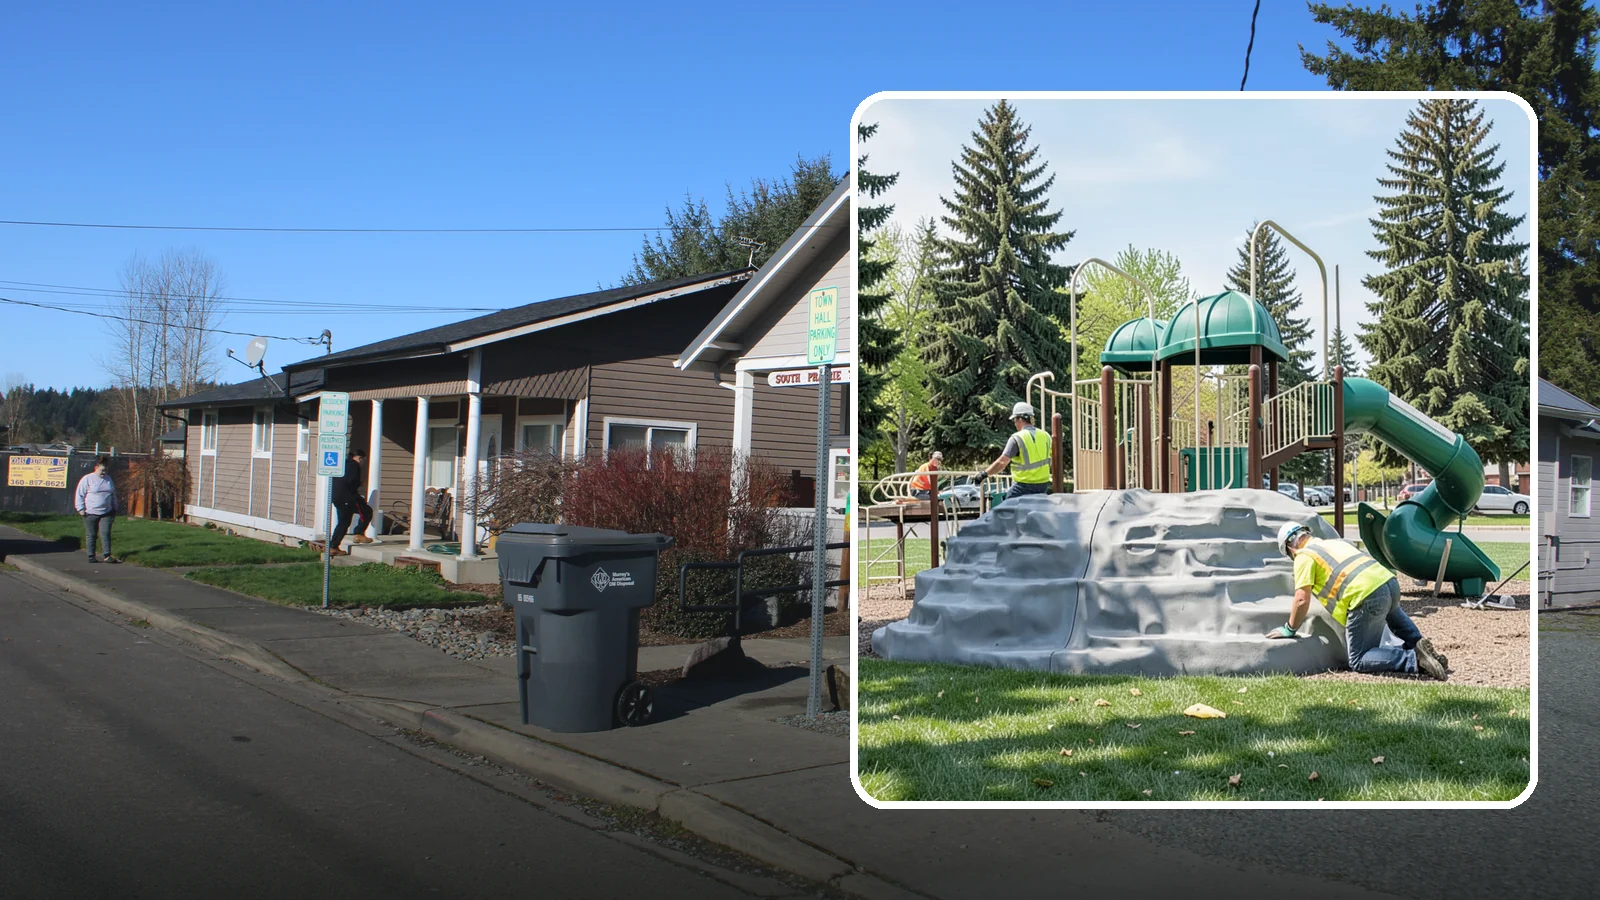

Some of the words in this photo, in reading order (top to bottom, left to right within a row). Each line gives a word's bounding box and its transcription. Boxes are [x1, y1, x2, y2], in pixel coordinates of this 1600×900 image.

[815, 294, 833, 308] TOWN
[814, 311, 831, 324] HALL
[810, 326, 836, 341] PARKING
[814, 343, 831, 357] ONLY
[775, 373, 801, 384] SOUTH
[808, 370, 842, 382] PRIE
